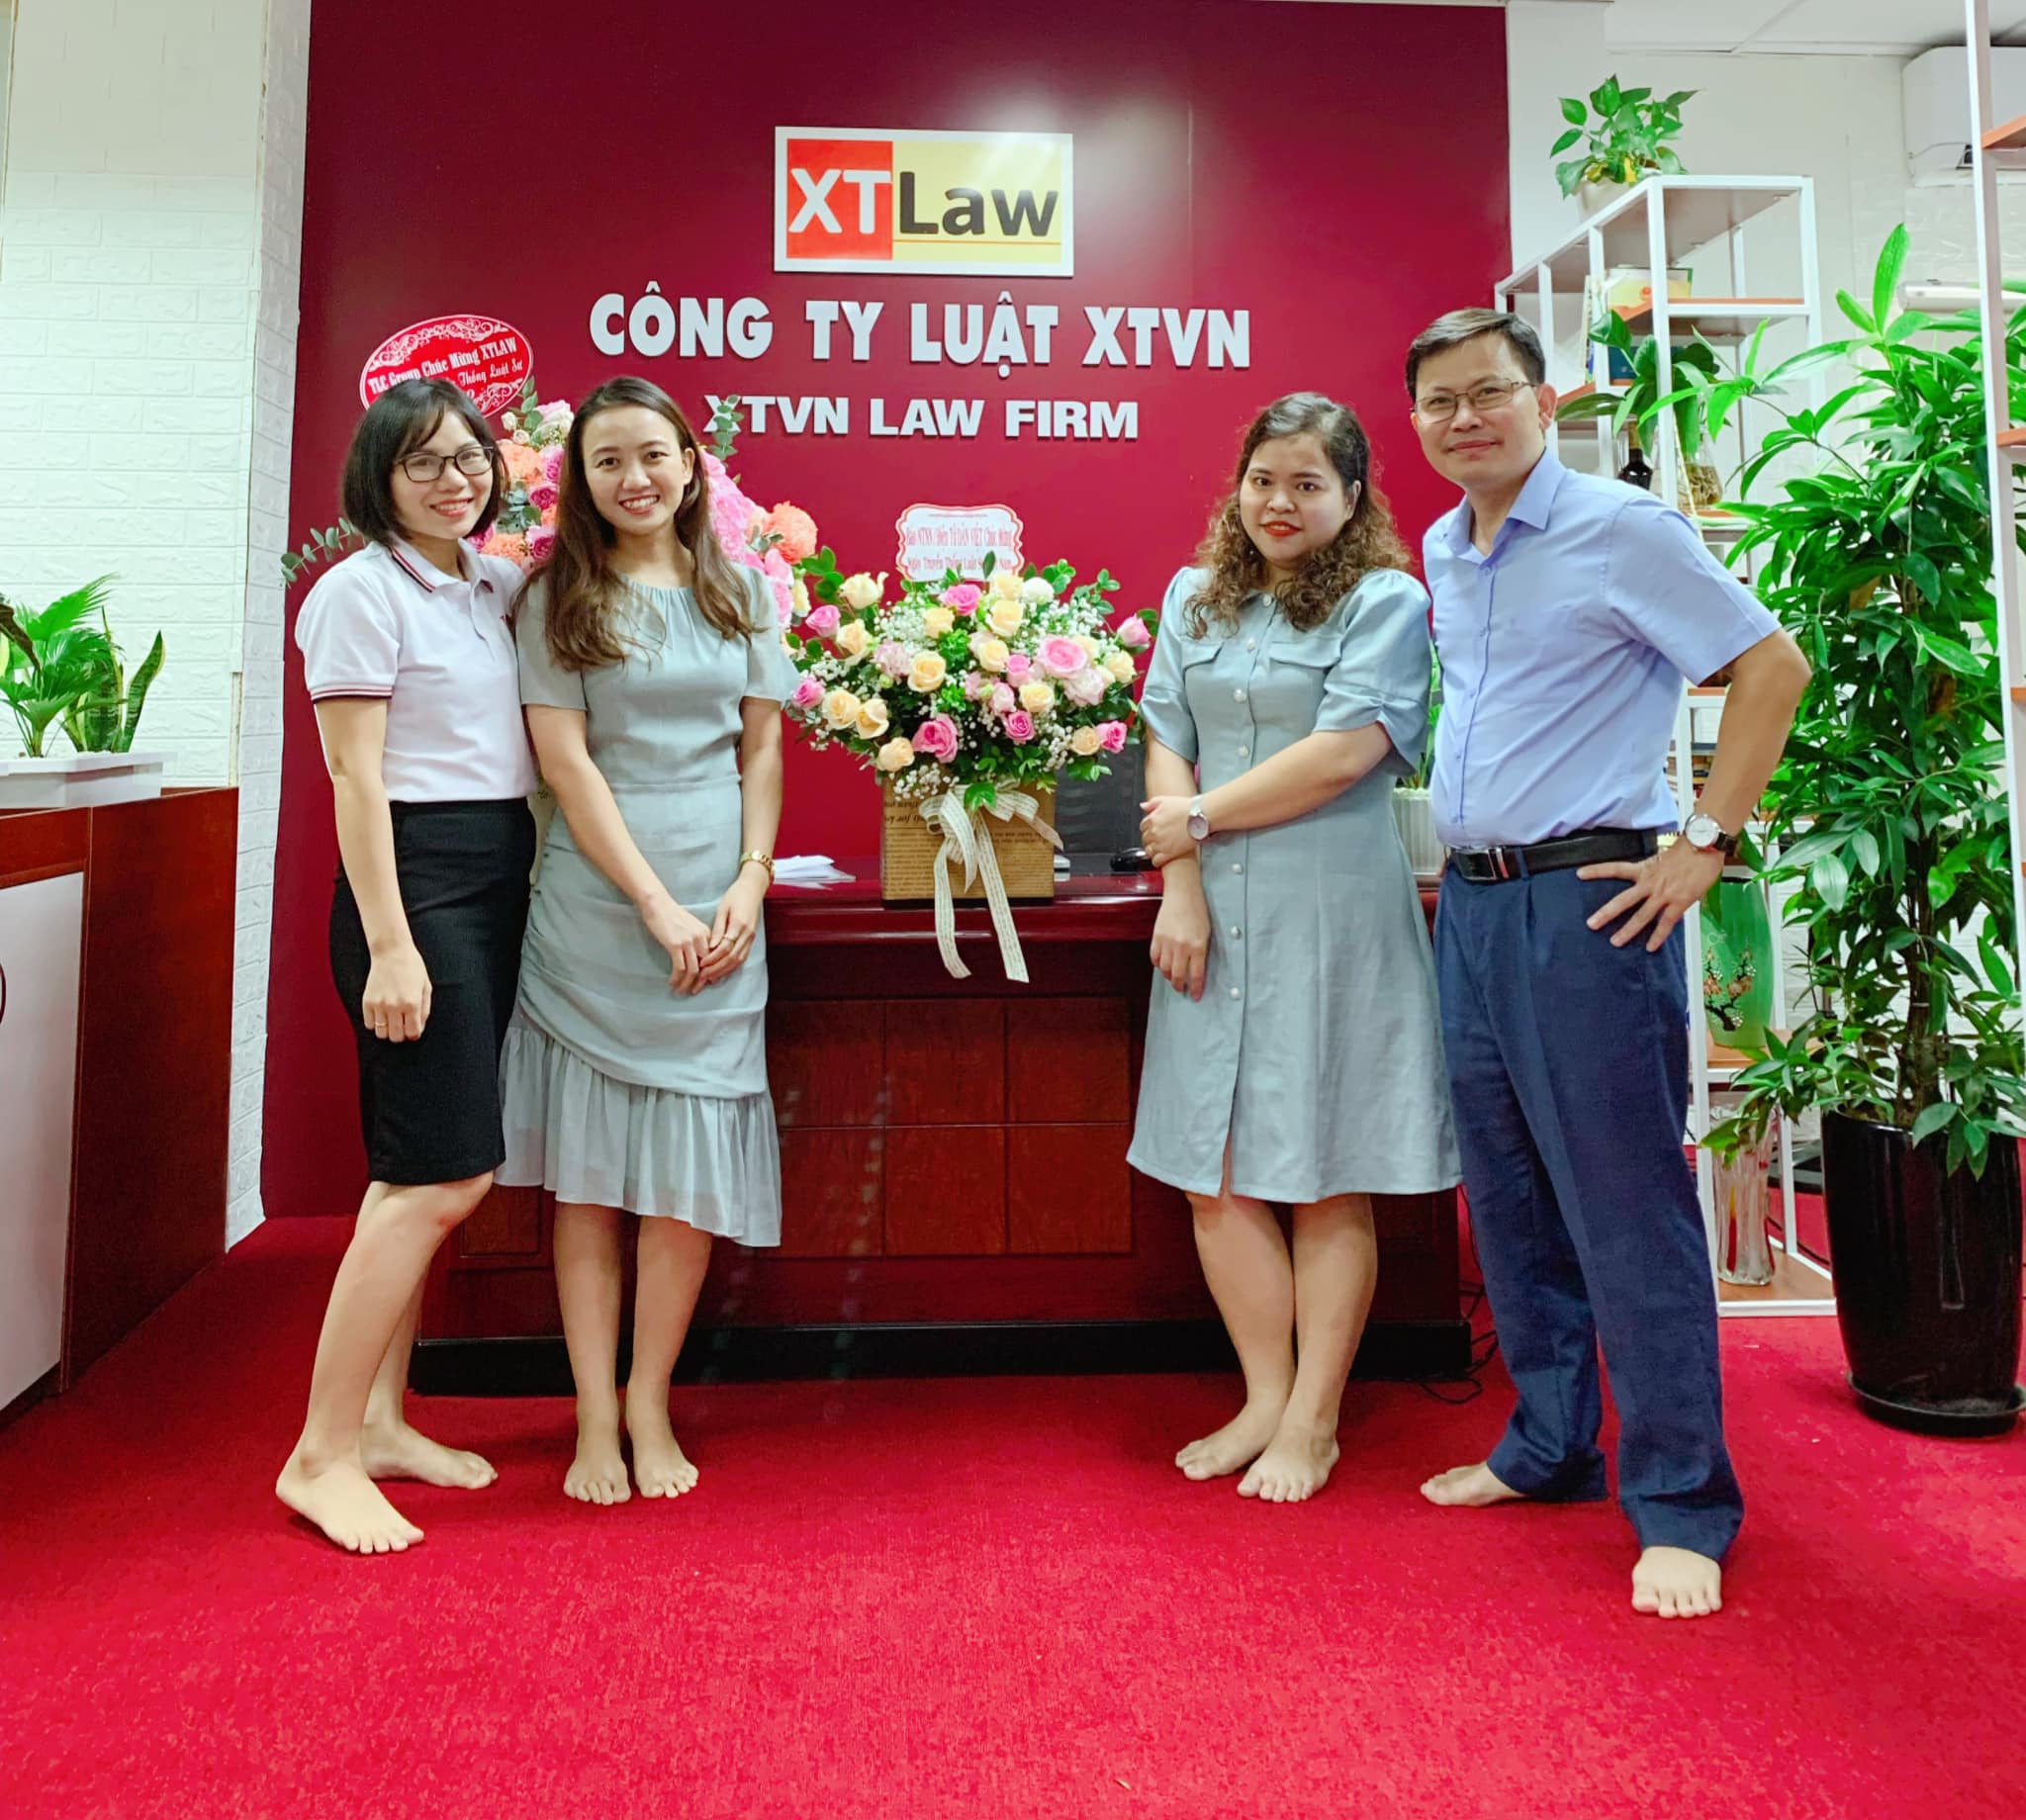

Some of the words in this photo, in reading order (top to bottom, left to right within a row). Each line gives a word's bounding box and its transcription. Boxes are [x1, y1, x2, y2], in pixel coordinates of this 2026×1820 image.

[590, 281, 774, 360] CÔNG
[806, 300, 884, 362] TY
[909, 291, 1059, 379] LUẬT
[1082, 307, 1250, 368] XTVN
[420, 358, 449, 377] Chúc
[480, 337, 517, 360] XTLAW
[703, 395, 850, 435] XTVN
[870, 399, 984, 437] LAW
[1005, 401, 1139, 439] FIRM
